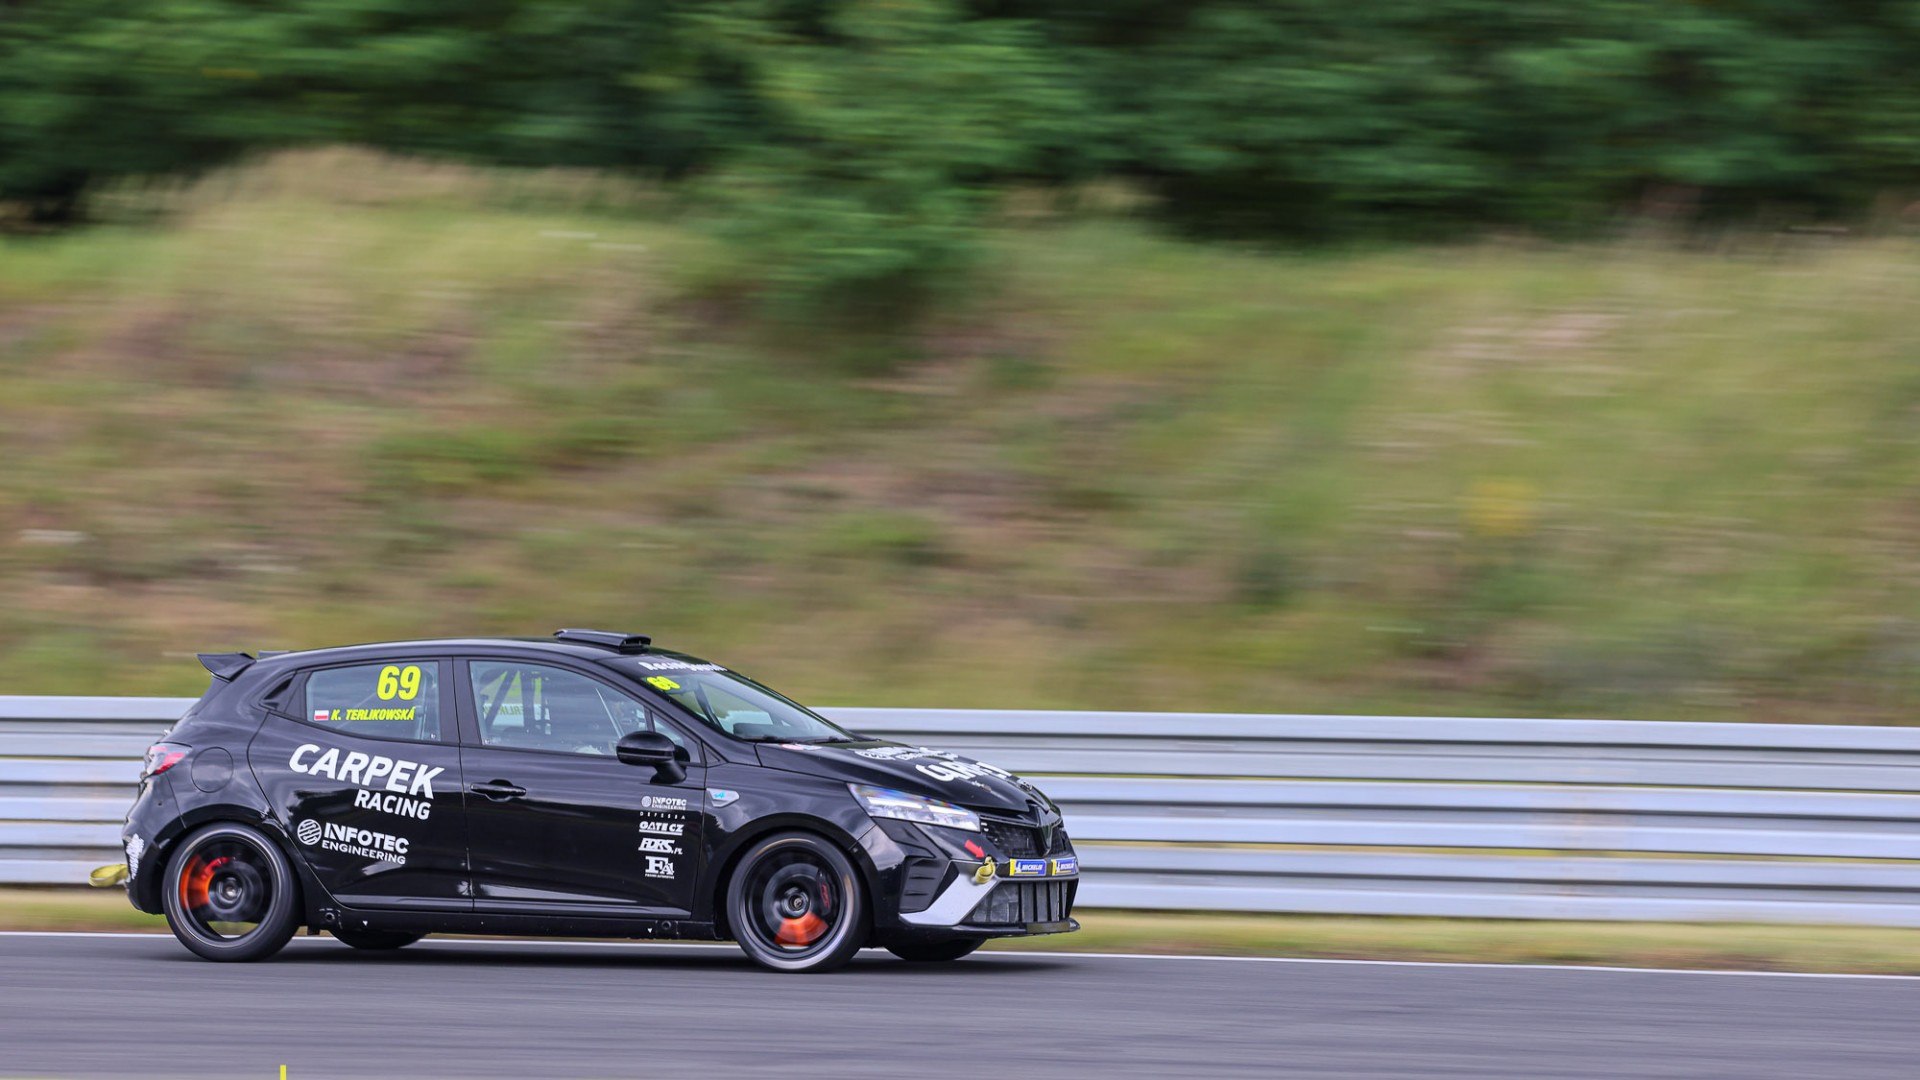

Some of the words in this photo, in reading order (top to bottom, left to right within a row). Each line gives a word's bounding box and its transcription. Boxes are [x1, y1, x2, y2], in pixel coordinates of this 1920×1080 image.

[376, 665, 422, 701] 69
[330, 709, 342, 721] K.
[345, 706, 417, 721] TERLIKOWSKÁ
[289, 743, 445, 800] CARPEK
[354, 789, 432, 821] RACING
[652, 796, 686, 805] INFOTEC
[321, 840, 406, 865] ENGINEERING
[324, 822, 410, 855] INFOTEC
